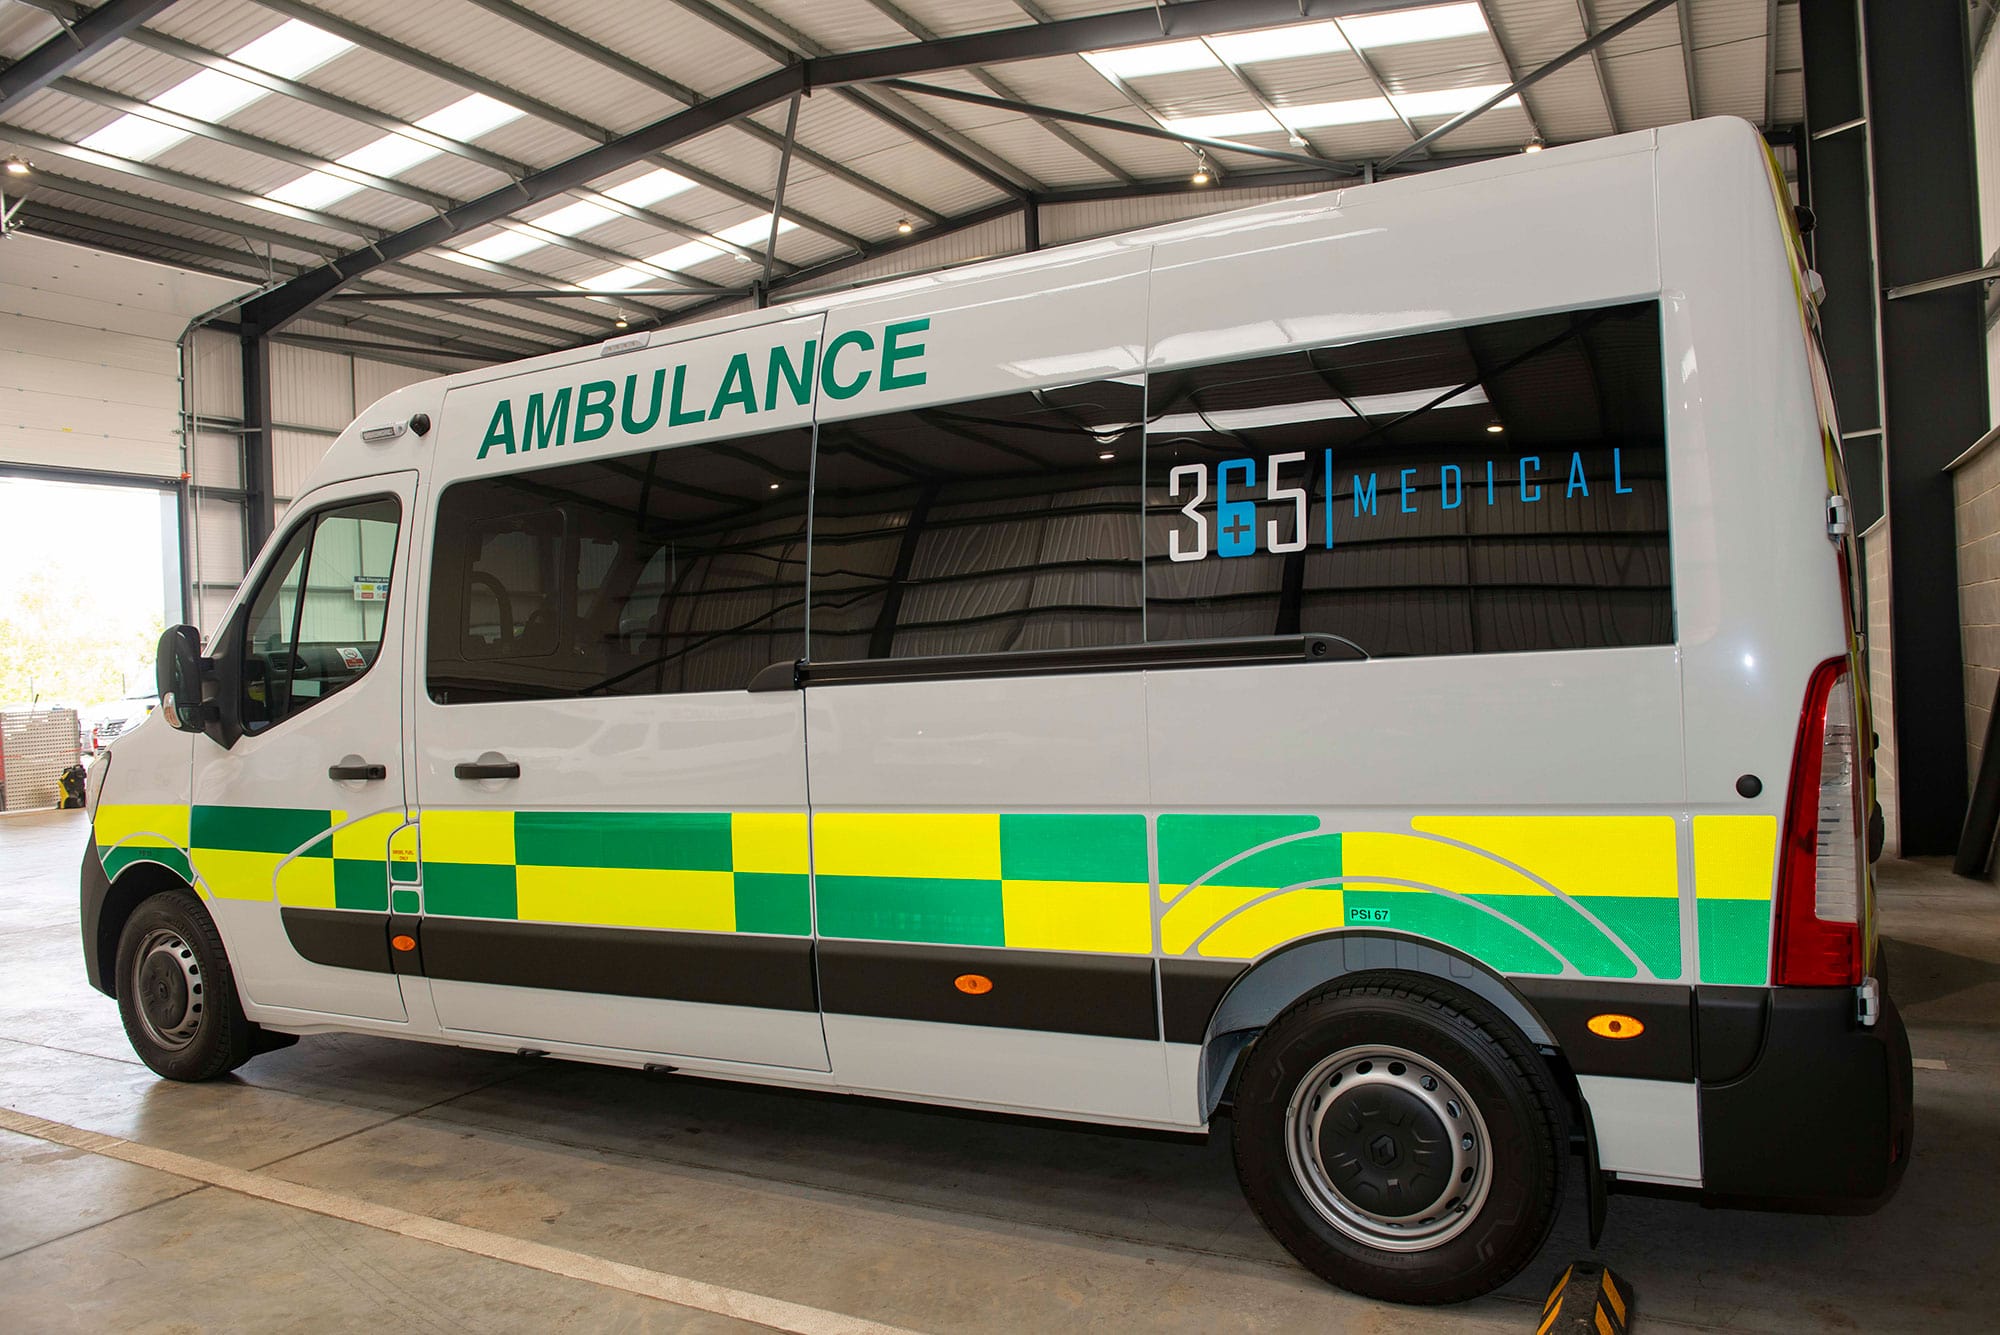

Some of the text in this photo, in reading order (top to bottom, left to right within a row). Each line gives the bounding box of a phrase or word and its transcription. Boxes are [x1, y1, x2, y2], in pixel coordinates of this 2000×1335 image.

[476, 318, 931, 460] AMBULANCE
[1169, 447, 1633, 563] 365 MEDICAL
[1351, 909, 1389, 920] PSI 67
